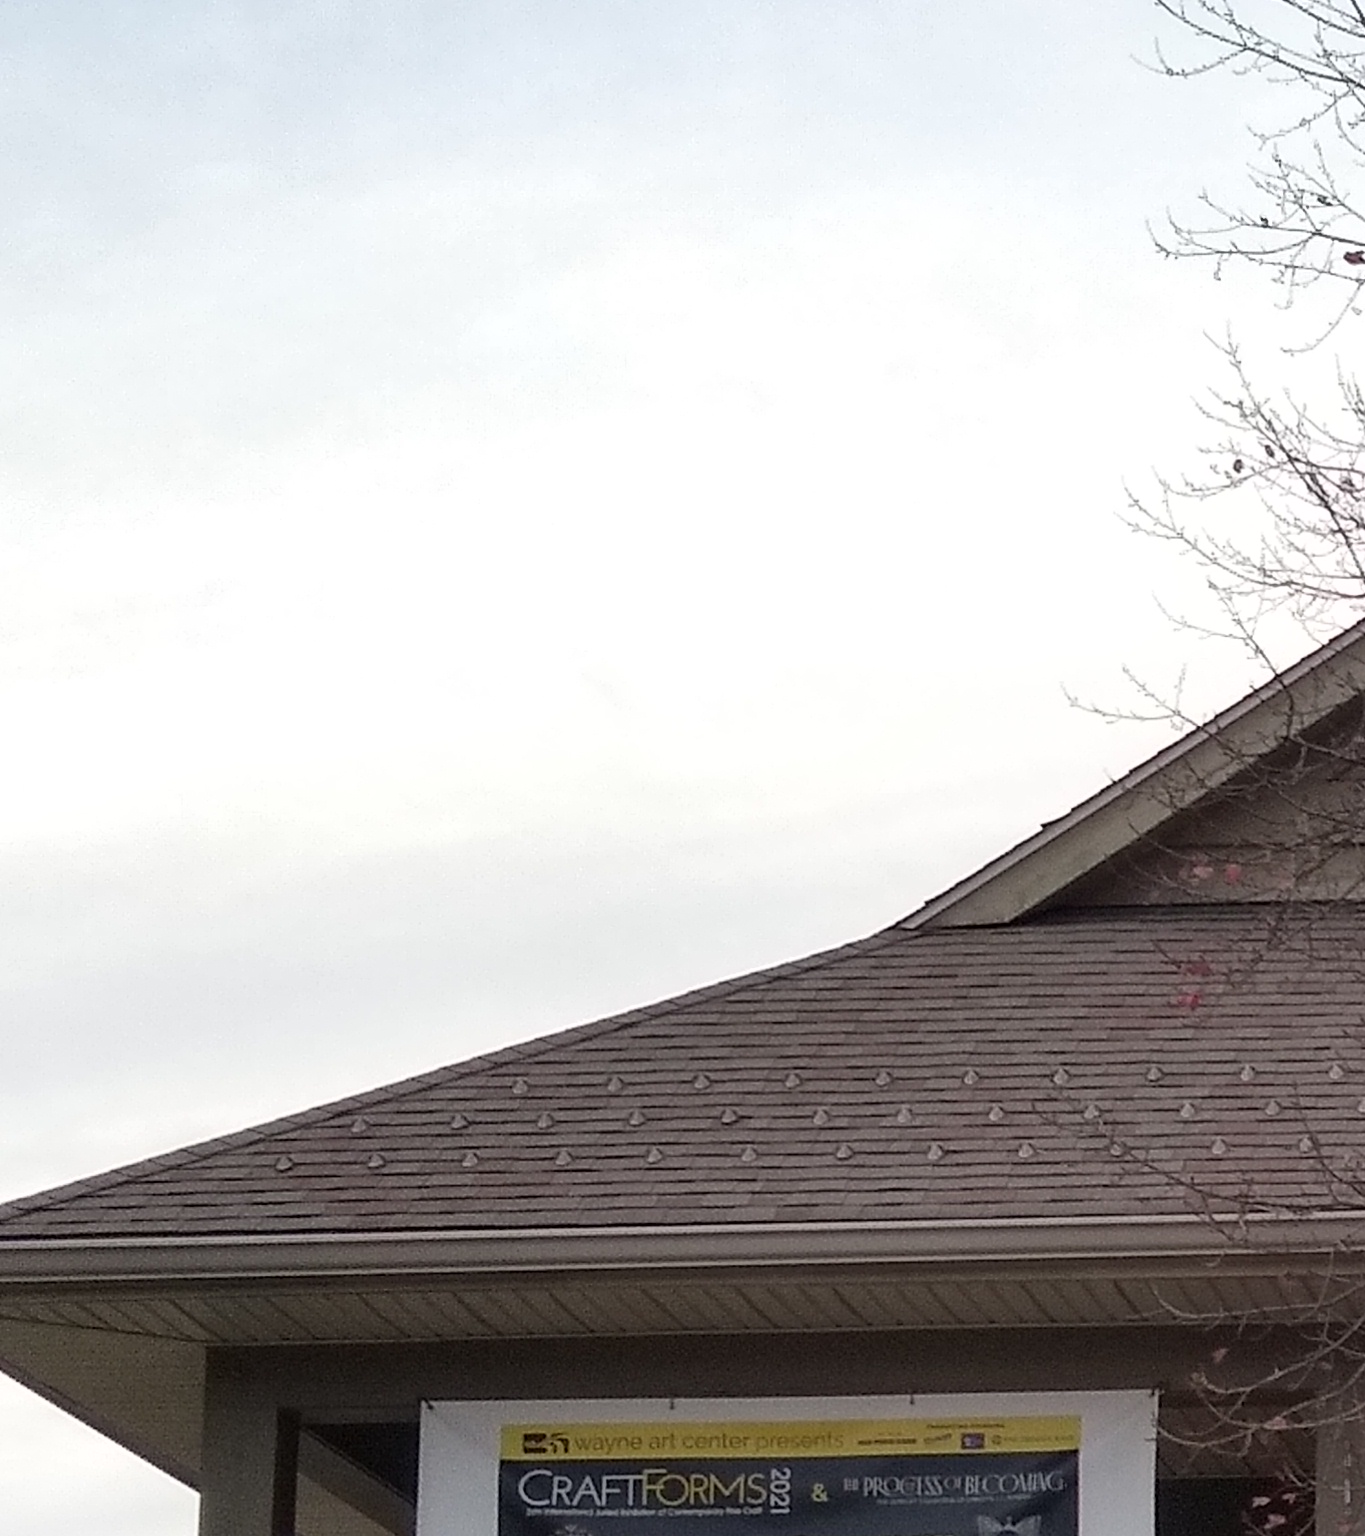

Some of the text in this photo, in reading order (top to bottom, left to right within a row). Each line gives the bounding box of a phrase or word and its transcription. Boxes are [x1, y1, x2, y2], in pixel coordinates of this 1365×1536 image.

[574, 1436, 643, 1454] wayne
[650, 1433, 676, 1450] art
[682, 1433, 750, 1450] center
[756, 1432, 844, 1453] presents
[769, 1467, 792, 1514] 2021
[811, 1483, 828, 1502] &
